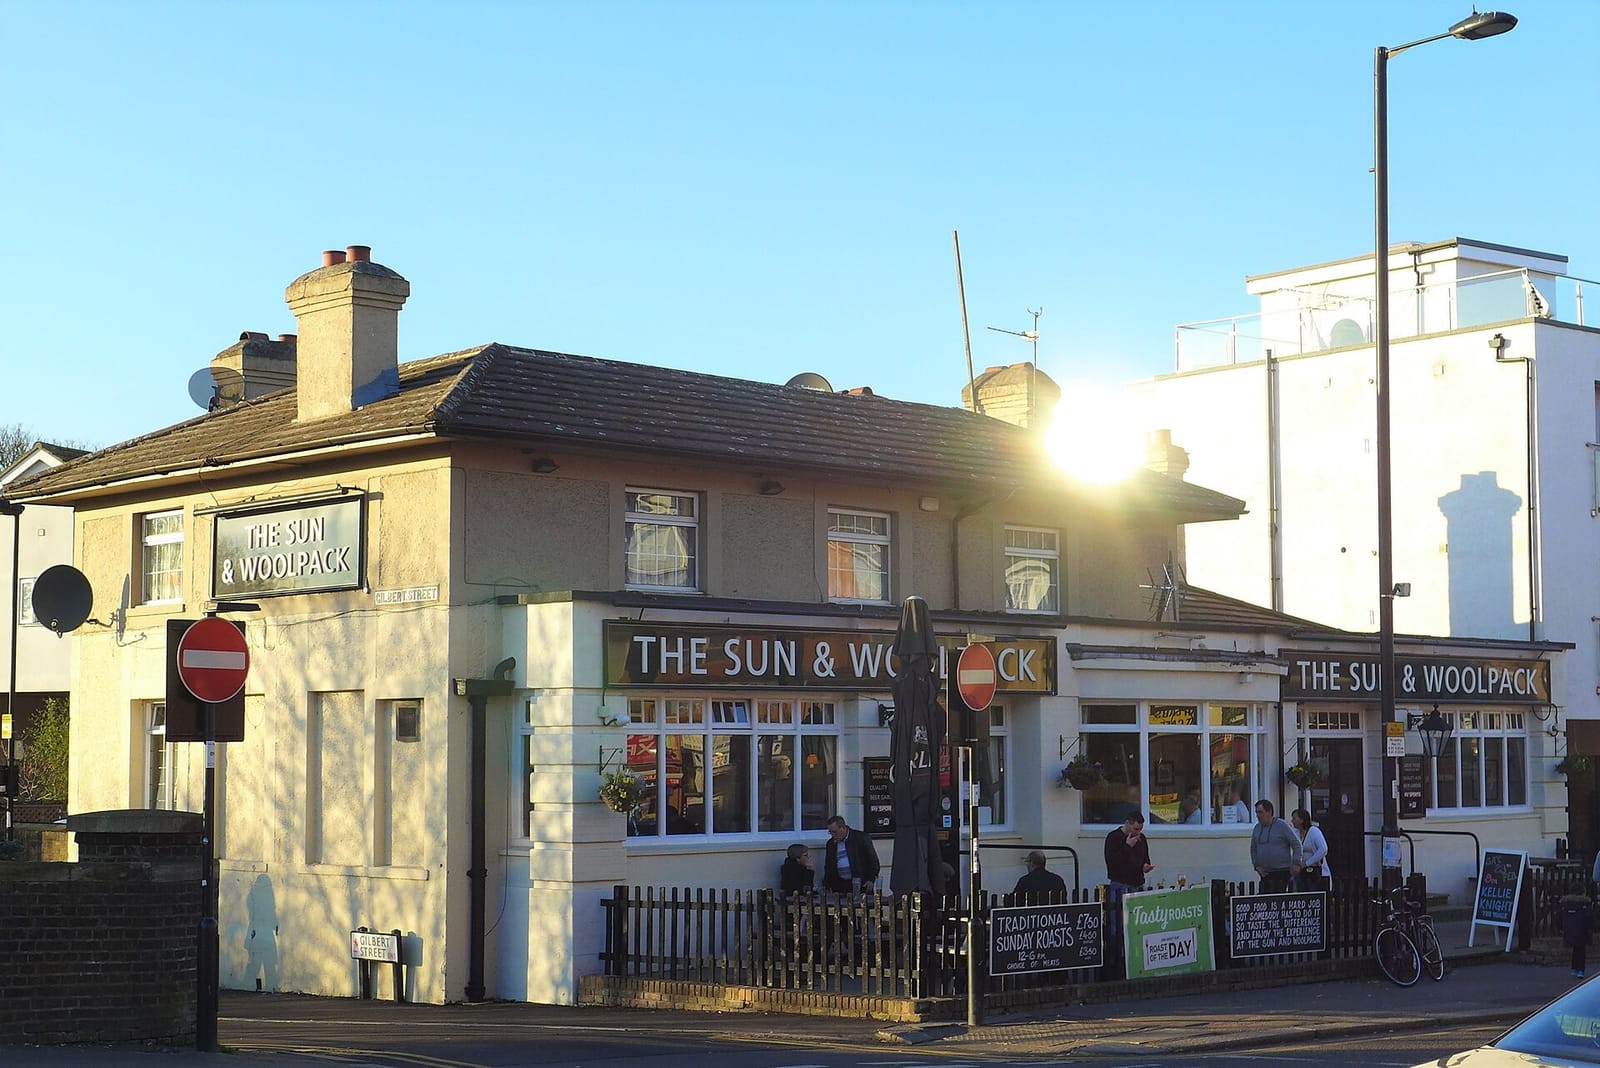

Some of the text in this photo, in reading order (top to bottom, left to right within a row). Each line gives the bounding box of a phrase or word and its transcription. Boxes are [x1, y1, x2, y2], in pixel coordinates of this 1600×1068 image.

[245, 517, 324, 549] THE SUN
[222, 547, 350, 584] & WOOLPACK
[408, 588, 437, 600] STREET
[633, 636, 707, 675] THE
[724, 638, 796, 677] SUN
[813, 641, 836, 678] &
[1297, 661, 1537, 695] THE SU & WOOLPACK
[1481, 887, 1512, 898] KELLIE
[1236, 899, 1320, 912] GOOD FOOD IS A HARD JOB
[1480, 899, 1513, 912] KNIGHT
[1133, 905, 1203, 929] Tasty ROASTS
[1236, 908, 1320, 921] BUT SOMEBODY HAS TO DO IT
[997, 913, 1069, 933] TRADITIONAL
[1236, 918, 1320, 931] SO TASTE THE DIFFERENCE
[996, 927, 1073, 952] SUNDAY ROASTS
[1237, 926, 1320, 940] AND ENJOY THE EXPERIENCE
[360, 936, 390, 947] GILBERT
[1149, 943, 1167, 953] ROAST
[1236, 935, 1320, 950] AT THE SUN AND WOOLPACK
[360, 947, 386, 958] STREET
[1150, 940, 1191, 962] OF THE DAY
